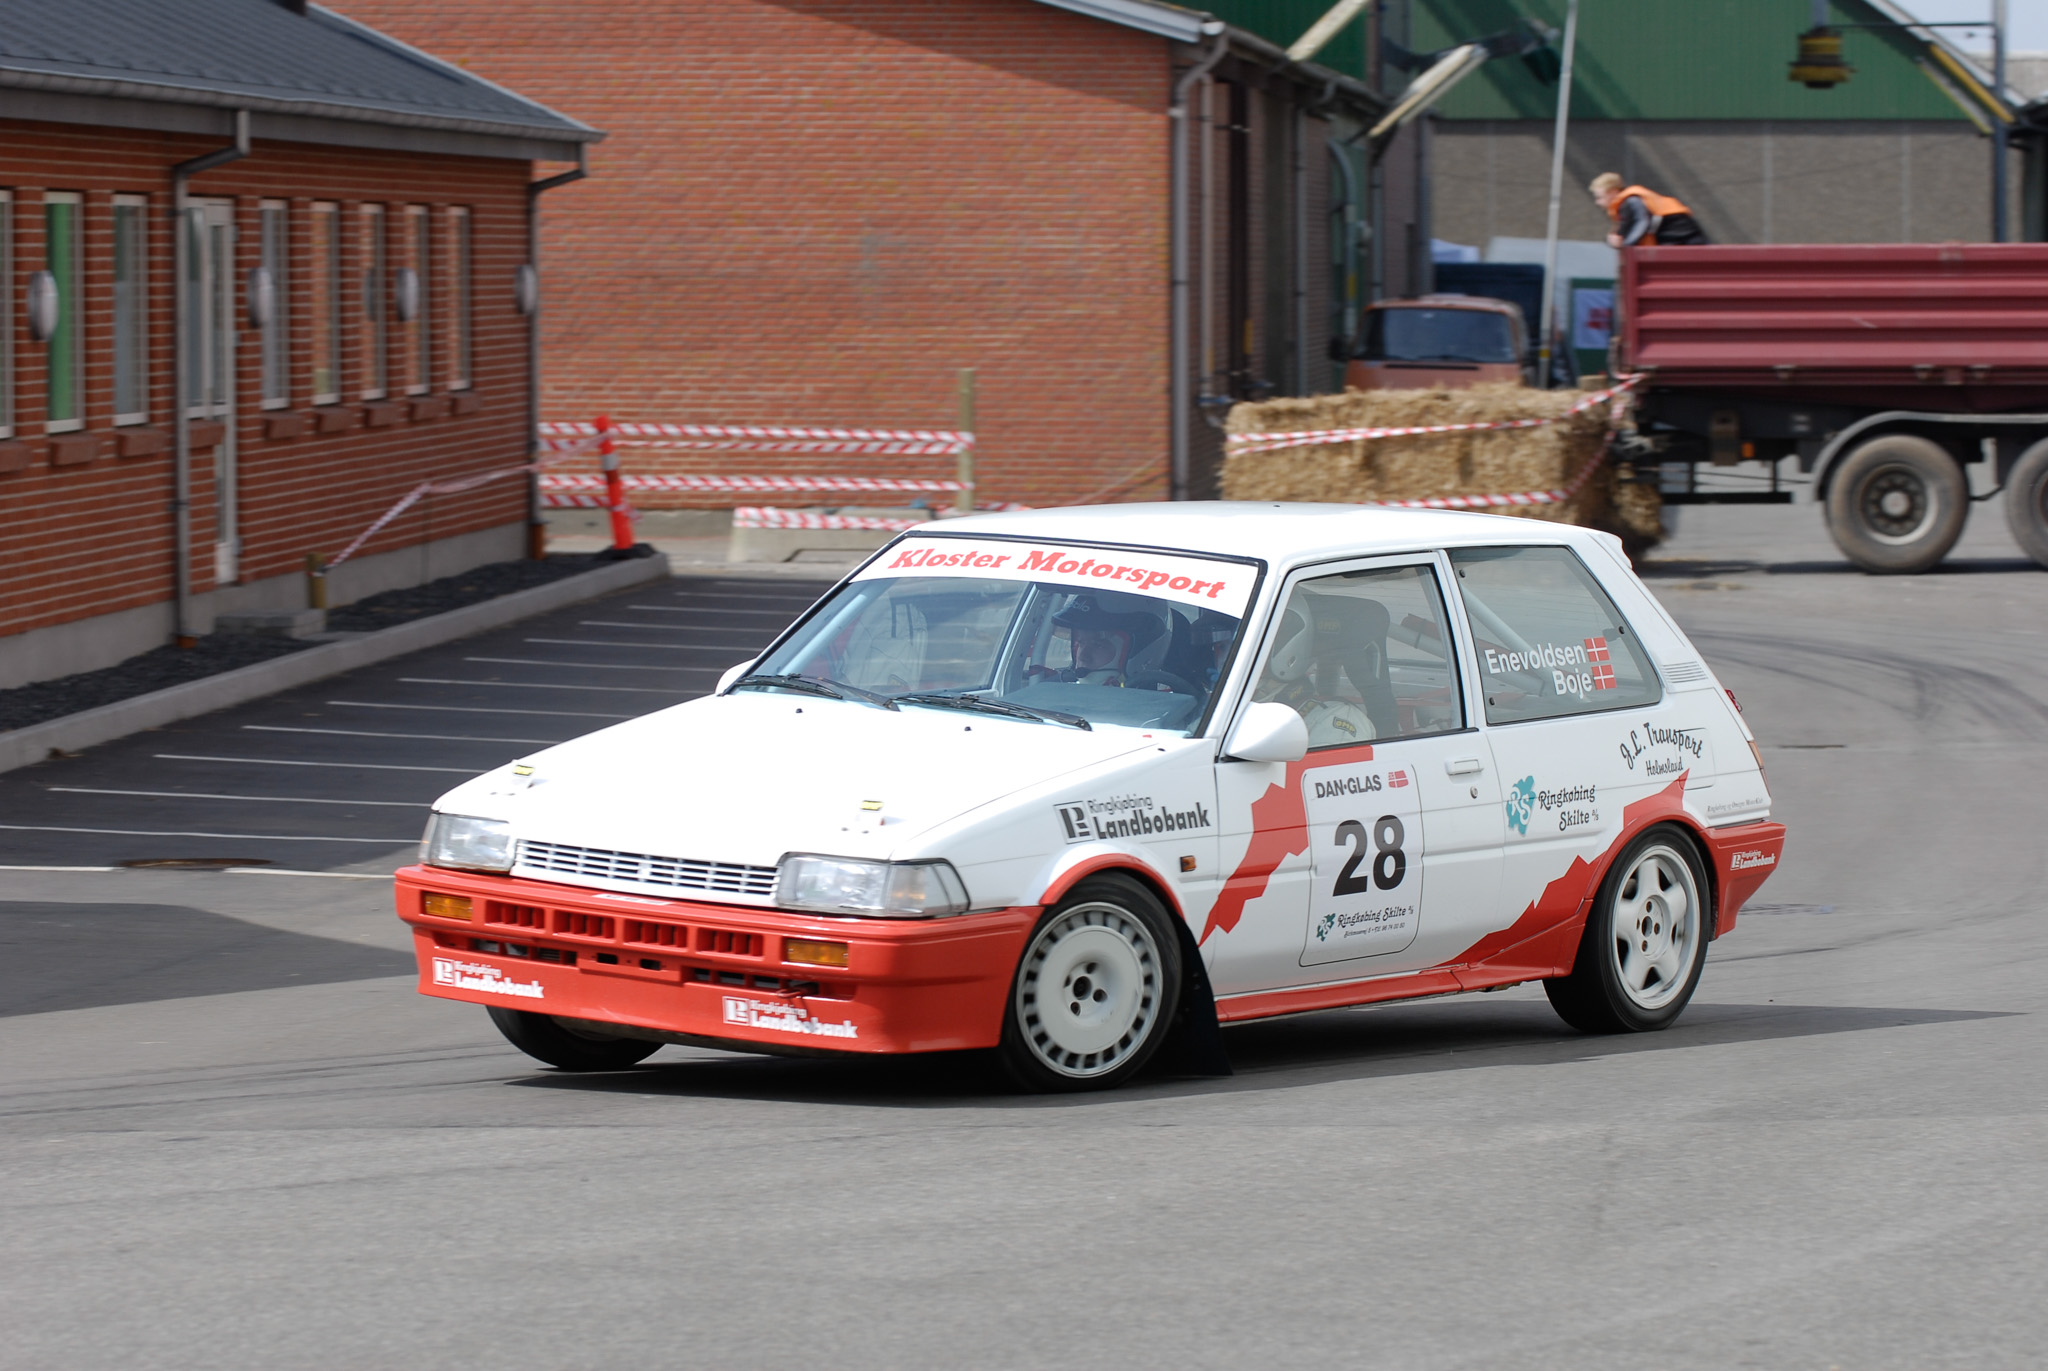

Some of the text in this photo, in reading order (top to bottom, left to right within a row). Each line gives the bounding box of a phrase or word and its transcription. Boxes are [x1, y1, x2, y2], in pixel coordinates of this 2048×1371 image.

[887, 548, 1226, 599] Kloster Motorsport
[1484, 643, 1586, 674] Enevoldsen
[1552, 668, 1593, 699] Boje
[1643, 722, 1703, 759] Transport
[1087, 794, 1153, 815] Ringkjøbing
[1538, 784, 1596, 811] Ringkøbing
[1093, 802, 1211, 839] Landbobank
[1559, 809, 1590, 831] Skilte
[1332, 814, 1407, 897] 28
[1337, 909, 1382, 928] Ringkøbing
[1382, 906, 1407, 921] Skilte
